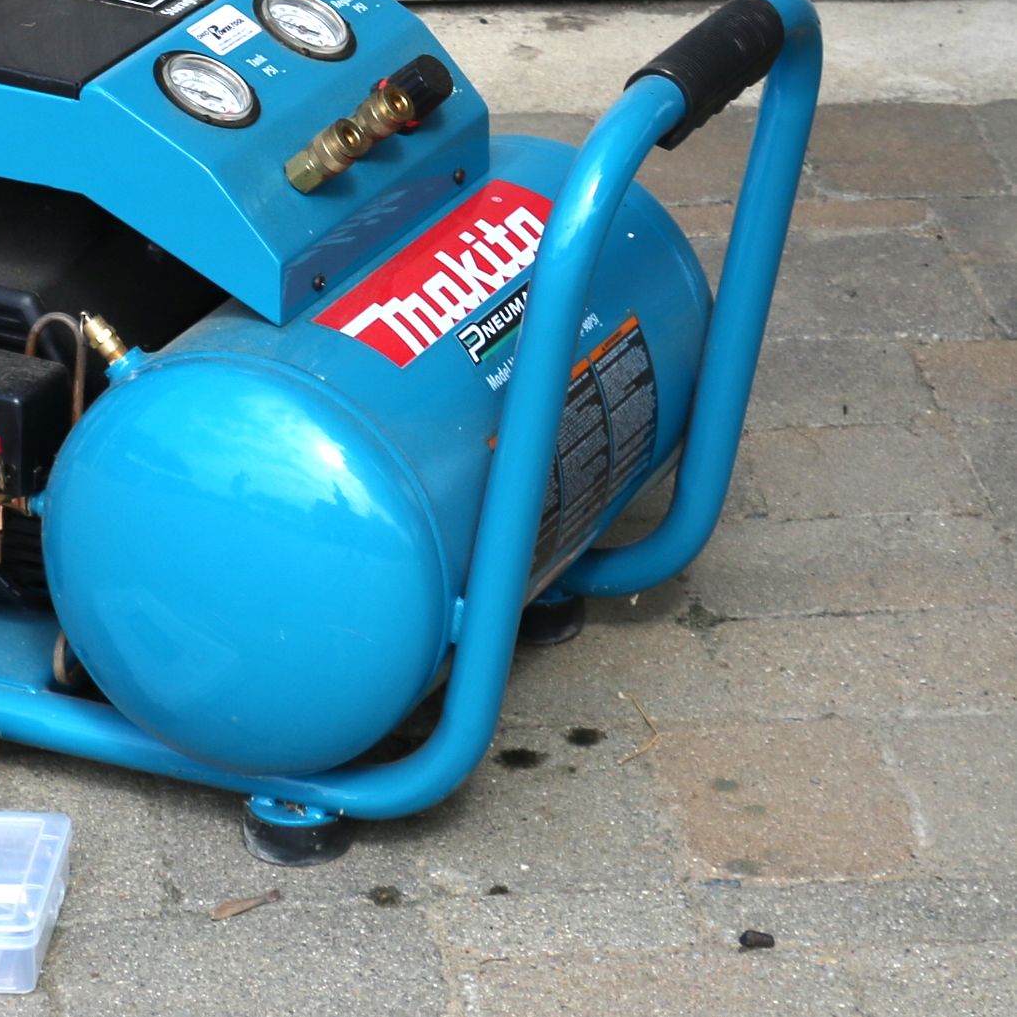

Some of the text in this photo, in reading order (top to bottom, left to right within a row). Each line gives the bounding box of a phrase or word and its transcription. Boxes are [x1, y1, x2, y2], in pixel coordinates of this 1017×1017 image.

[352, 2, 369, 14] PSI
[245, 53, 268, 68] Tank
[262, 64, 279, 77] PSI
[486, 361, 512, 392] Model
